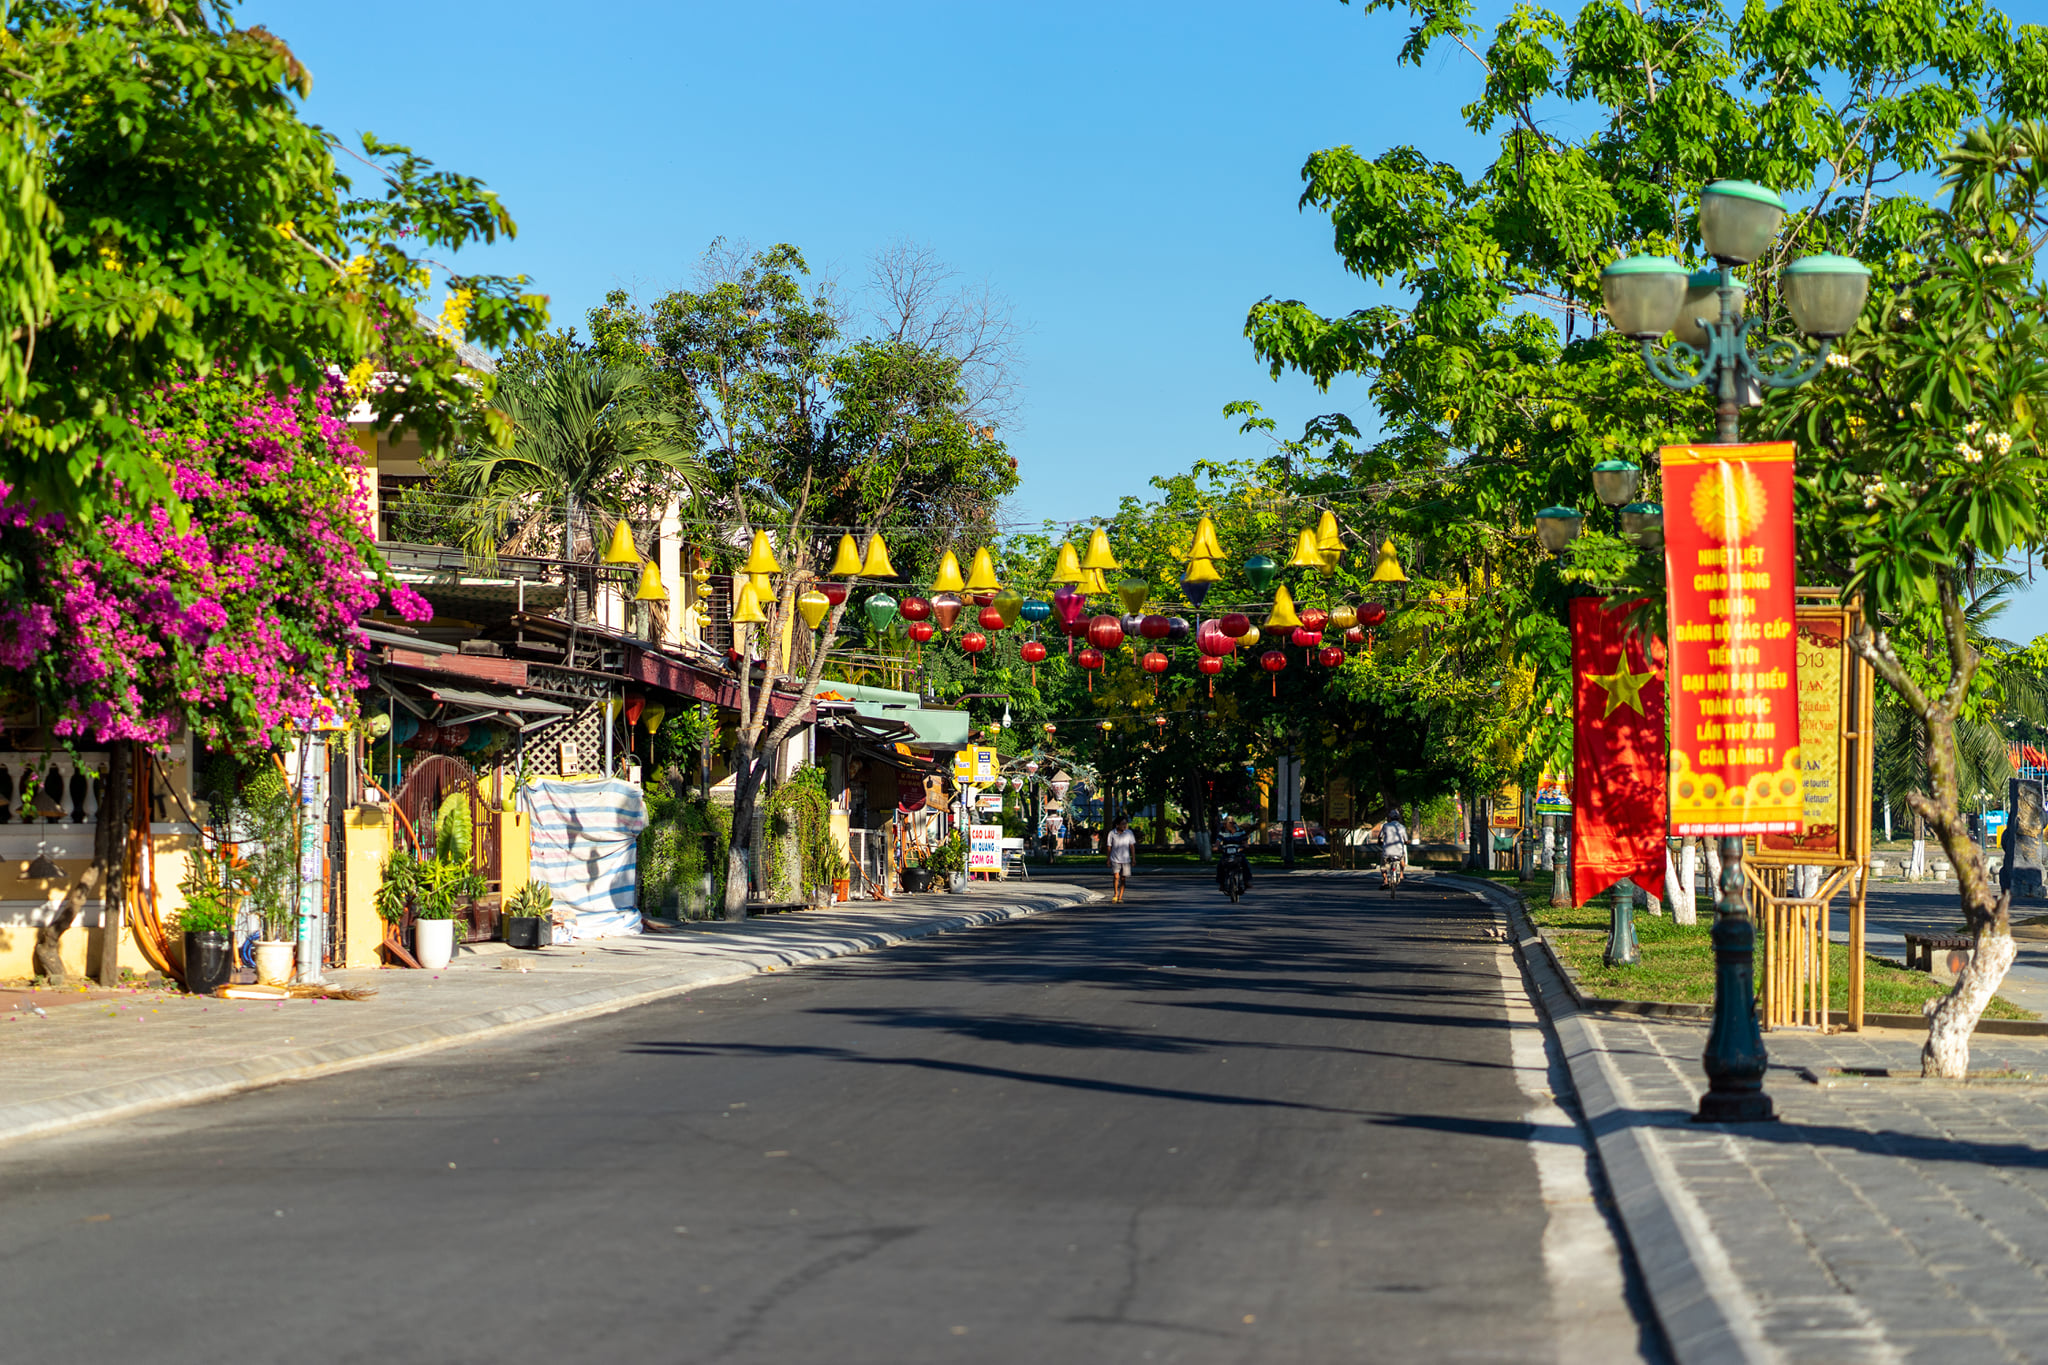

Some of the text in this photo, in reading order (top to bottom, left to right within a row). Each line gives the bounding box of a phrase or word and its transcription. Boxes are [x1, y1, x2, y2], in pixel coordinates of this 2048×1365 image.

[1698, 544, 1764, 568] NHIỆT LIỆT
[1694, 571, 1728, 591] CHÀO
[1734, 620, 1761, 640] CÁC
[1763, 617, 1791, 640] CẤP
[1796, 652, 1824, 668] 013
[1682, 674, 1705, 694] ĐẠI
[1707, 670, 1728, 693] HỘI
[1731, 672, 1754, 693] ĐẠI
[1806, 680, 1824, 691] AN
[1699, 692, 1771, 717] TOÀN QUỐC
[1804, 760, 1821, 770] AN
[1810, 778, 1829, 788] tourist
[972, 830, 983, 839] CAO
